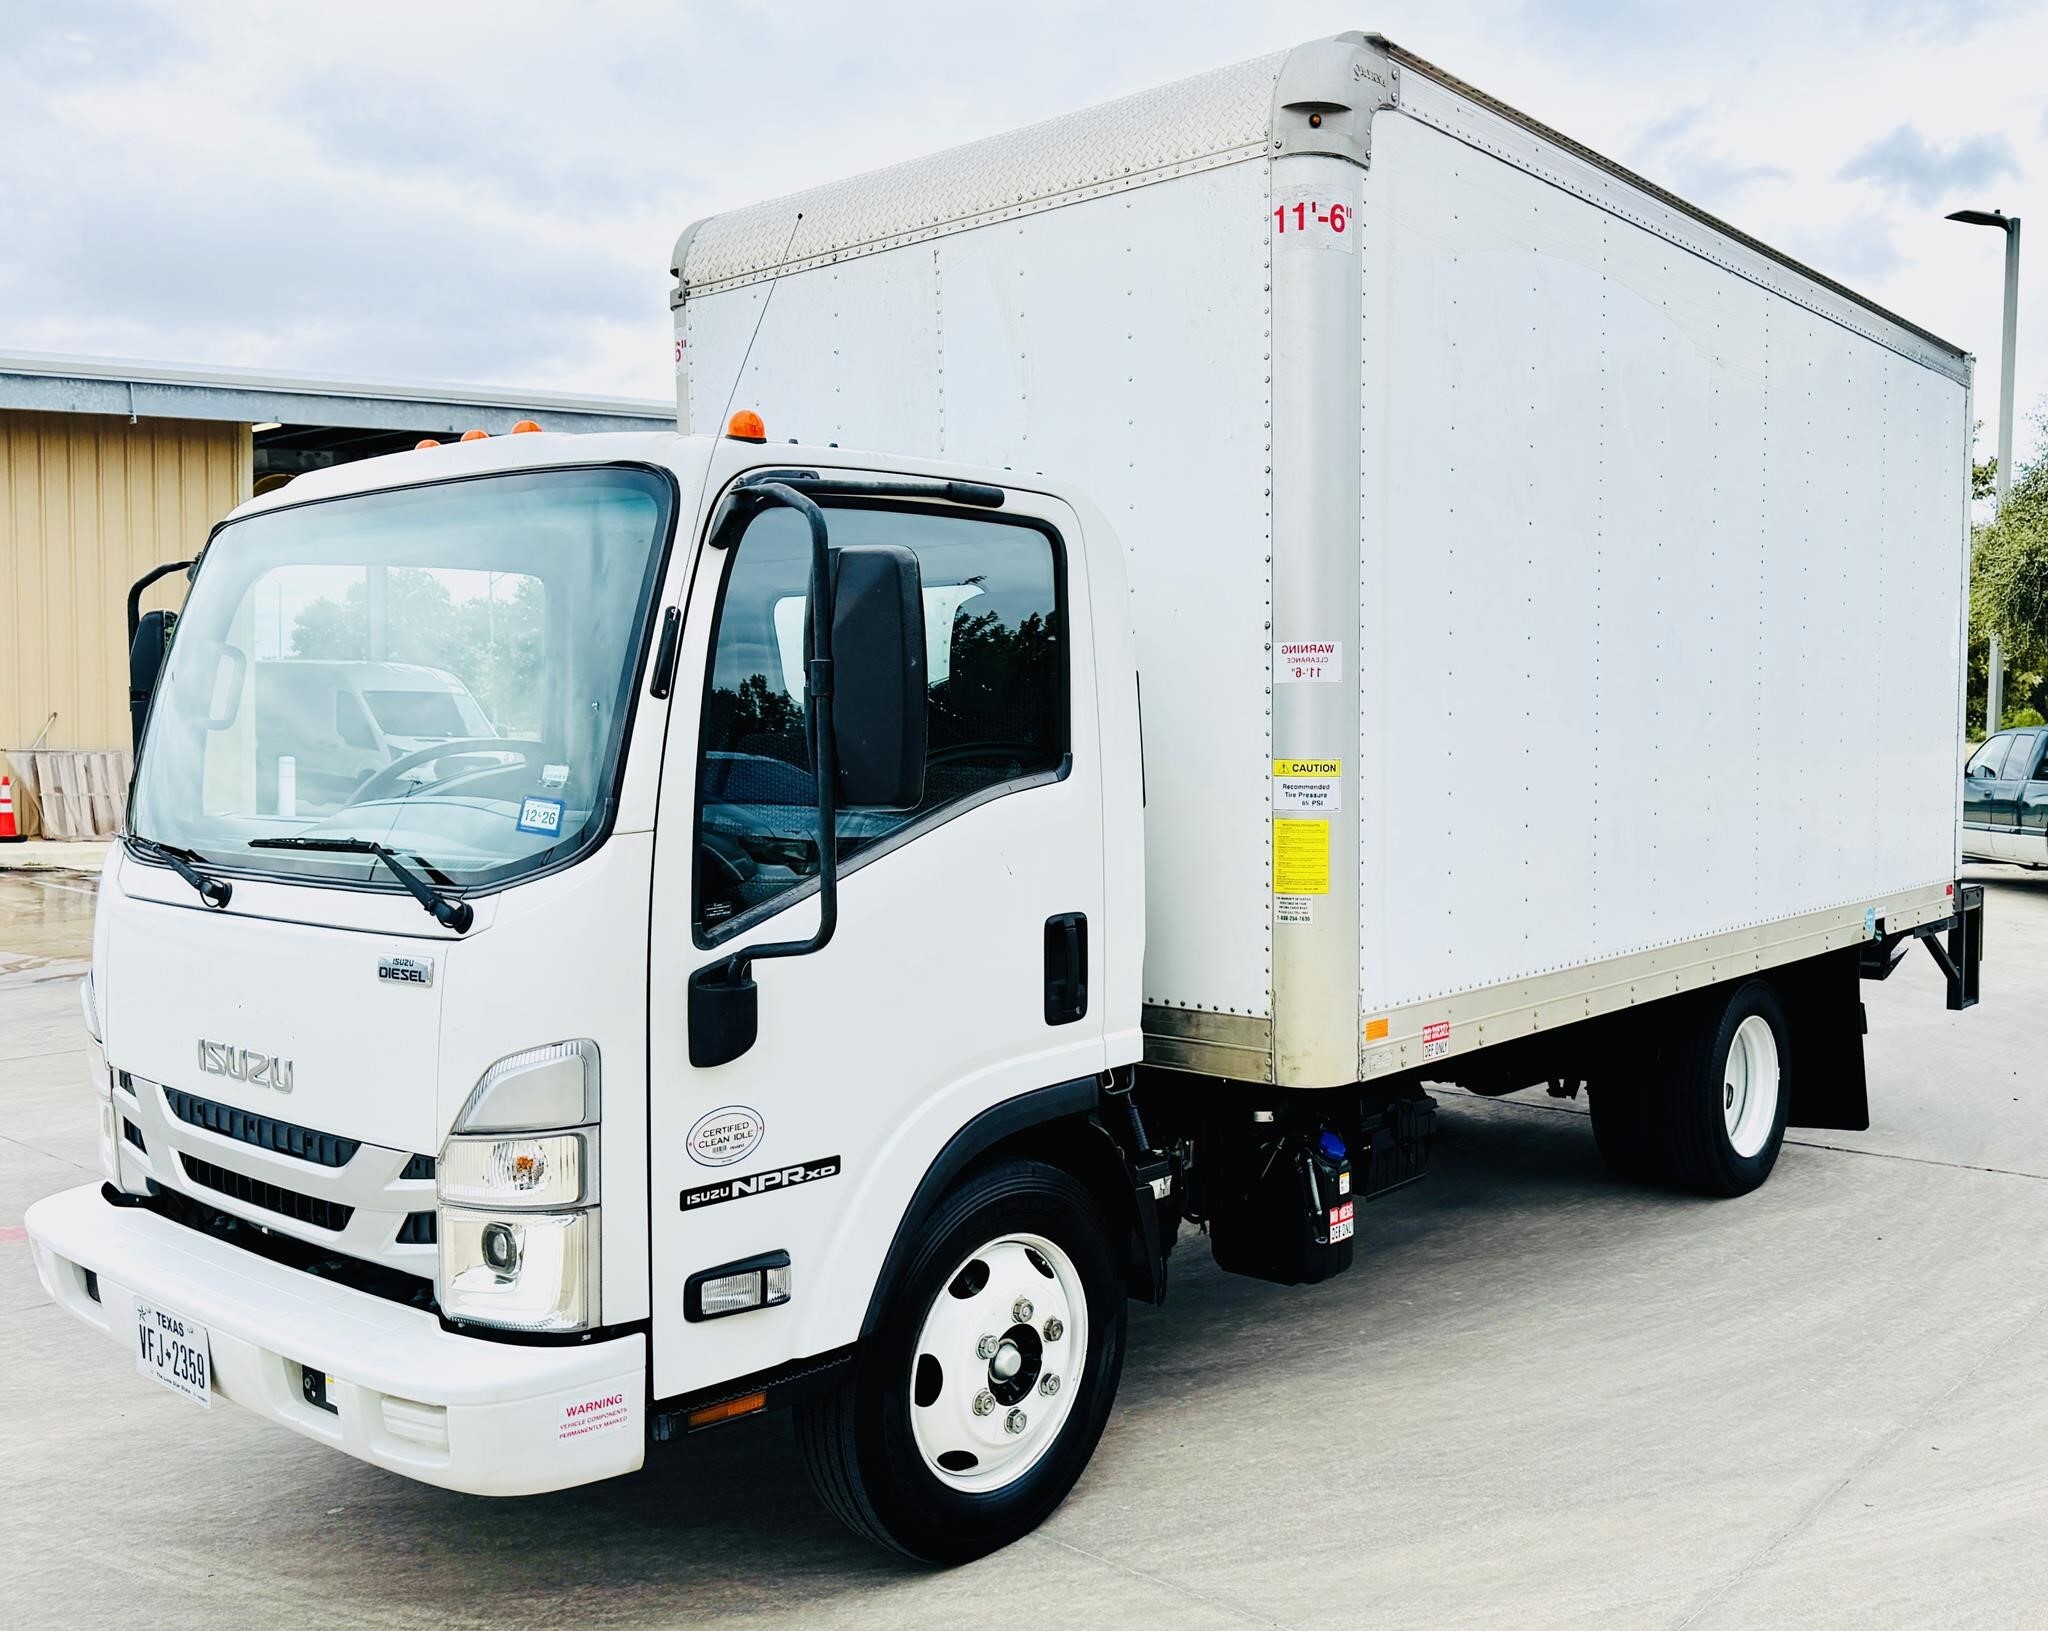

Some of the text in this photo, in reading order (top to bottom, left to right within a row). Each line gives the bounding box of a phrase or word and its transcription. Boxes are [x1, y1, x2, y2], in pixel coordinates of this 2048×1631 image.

[1274, 201, 1352, 233] 11'-6"
[1292, 764, 1337, 772] CAUTION
[392, 958, 414, 967] ISUZU
[378, 966, 426, 983] DIESEL
[197, 1038, 294, 1094] ISUZU
[702, 1121, 750, 1138] CERTIFIED
[698, 1135, 730, 1149] CLEAN
[734, 1130, 754, 1141] IDLE
[686, 1186, 730, 1205] ISUZU
[156, 1311, 184, 1337] TEXAS
[566, 1393, 623, 1417] WARNING
